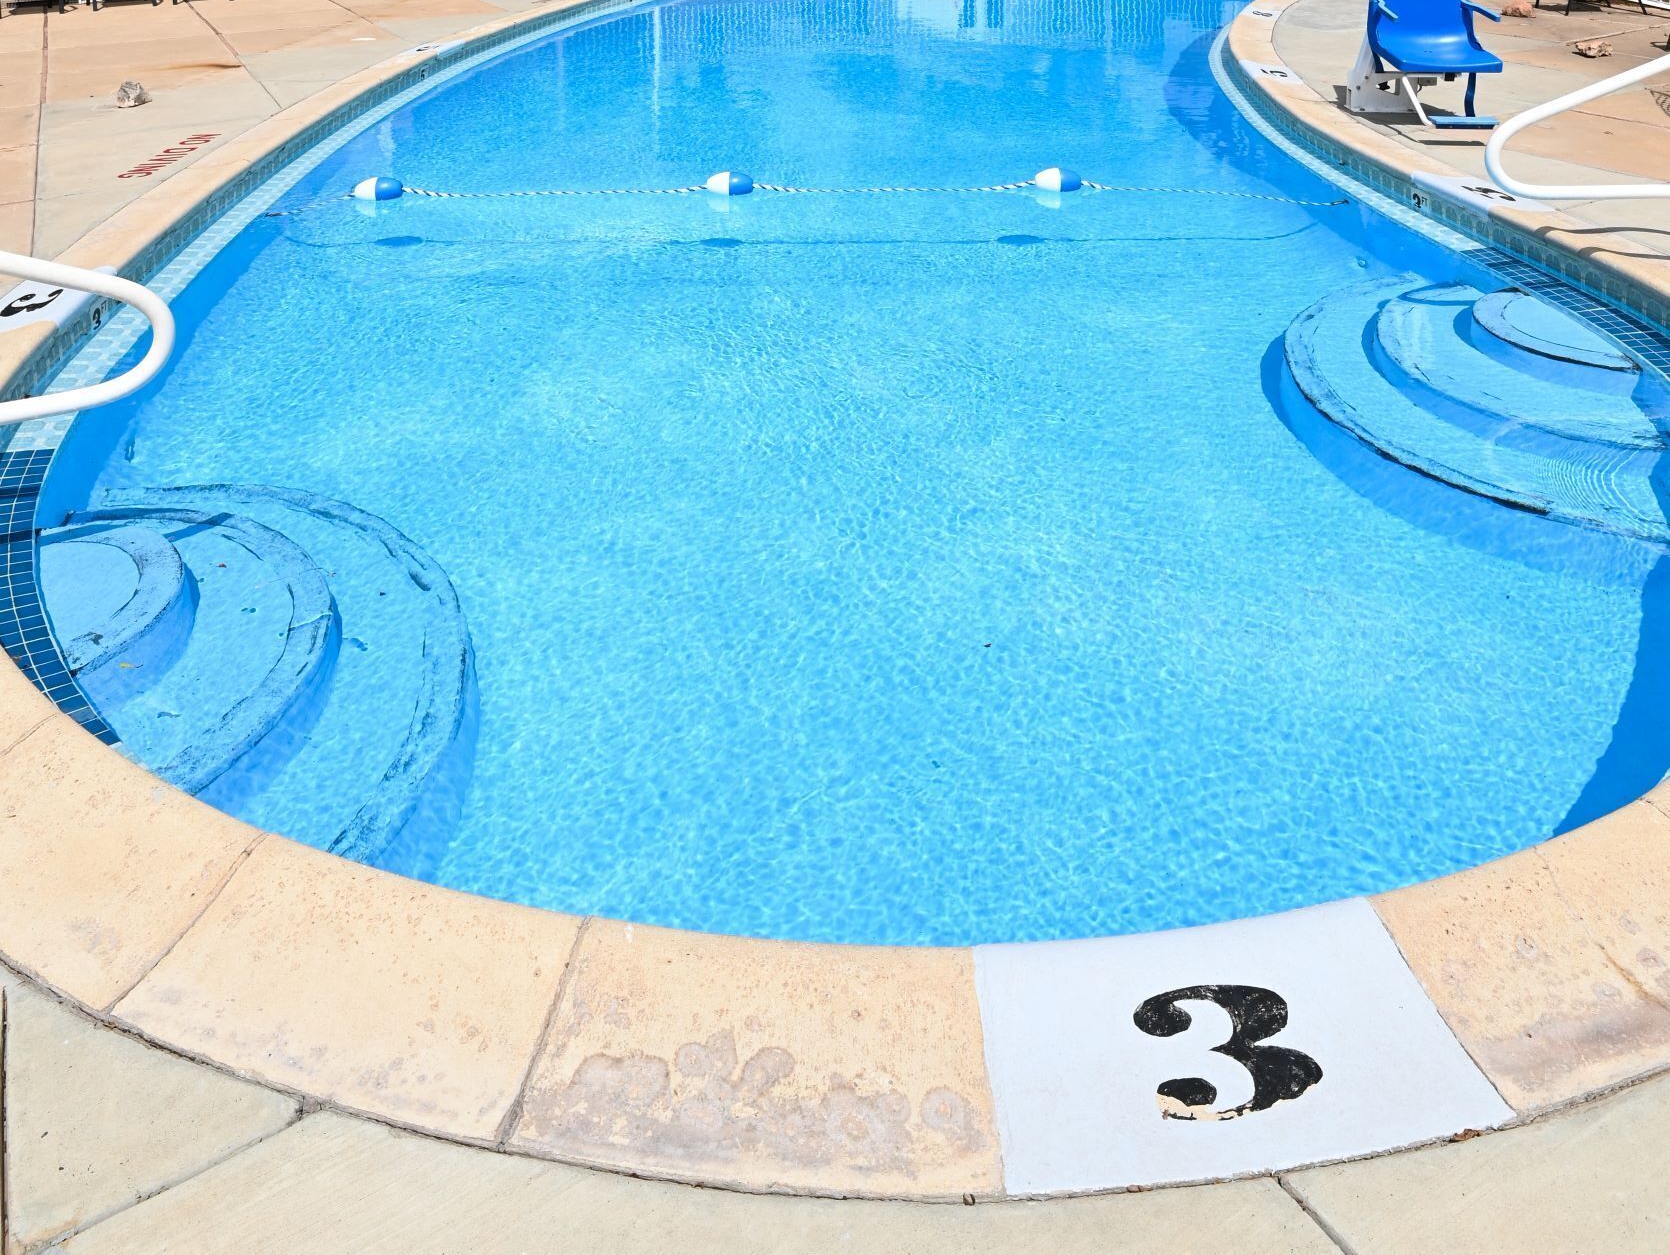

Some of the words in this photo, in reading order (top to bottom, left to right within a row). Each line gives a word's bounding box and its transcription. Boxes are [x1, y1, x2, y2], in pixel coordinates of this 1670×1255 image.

[178, 133, 222, 146] NO
[117, 146, 199, 179] DIVING
[0, 288, 64, 317] 3
[92, 307, 102, 331] 3
[1133, 984, 1324, 1122] 3
